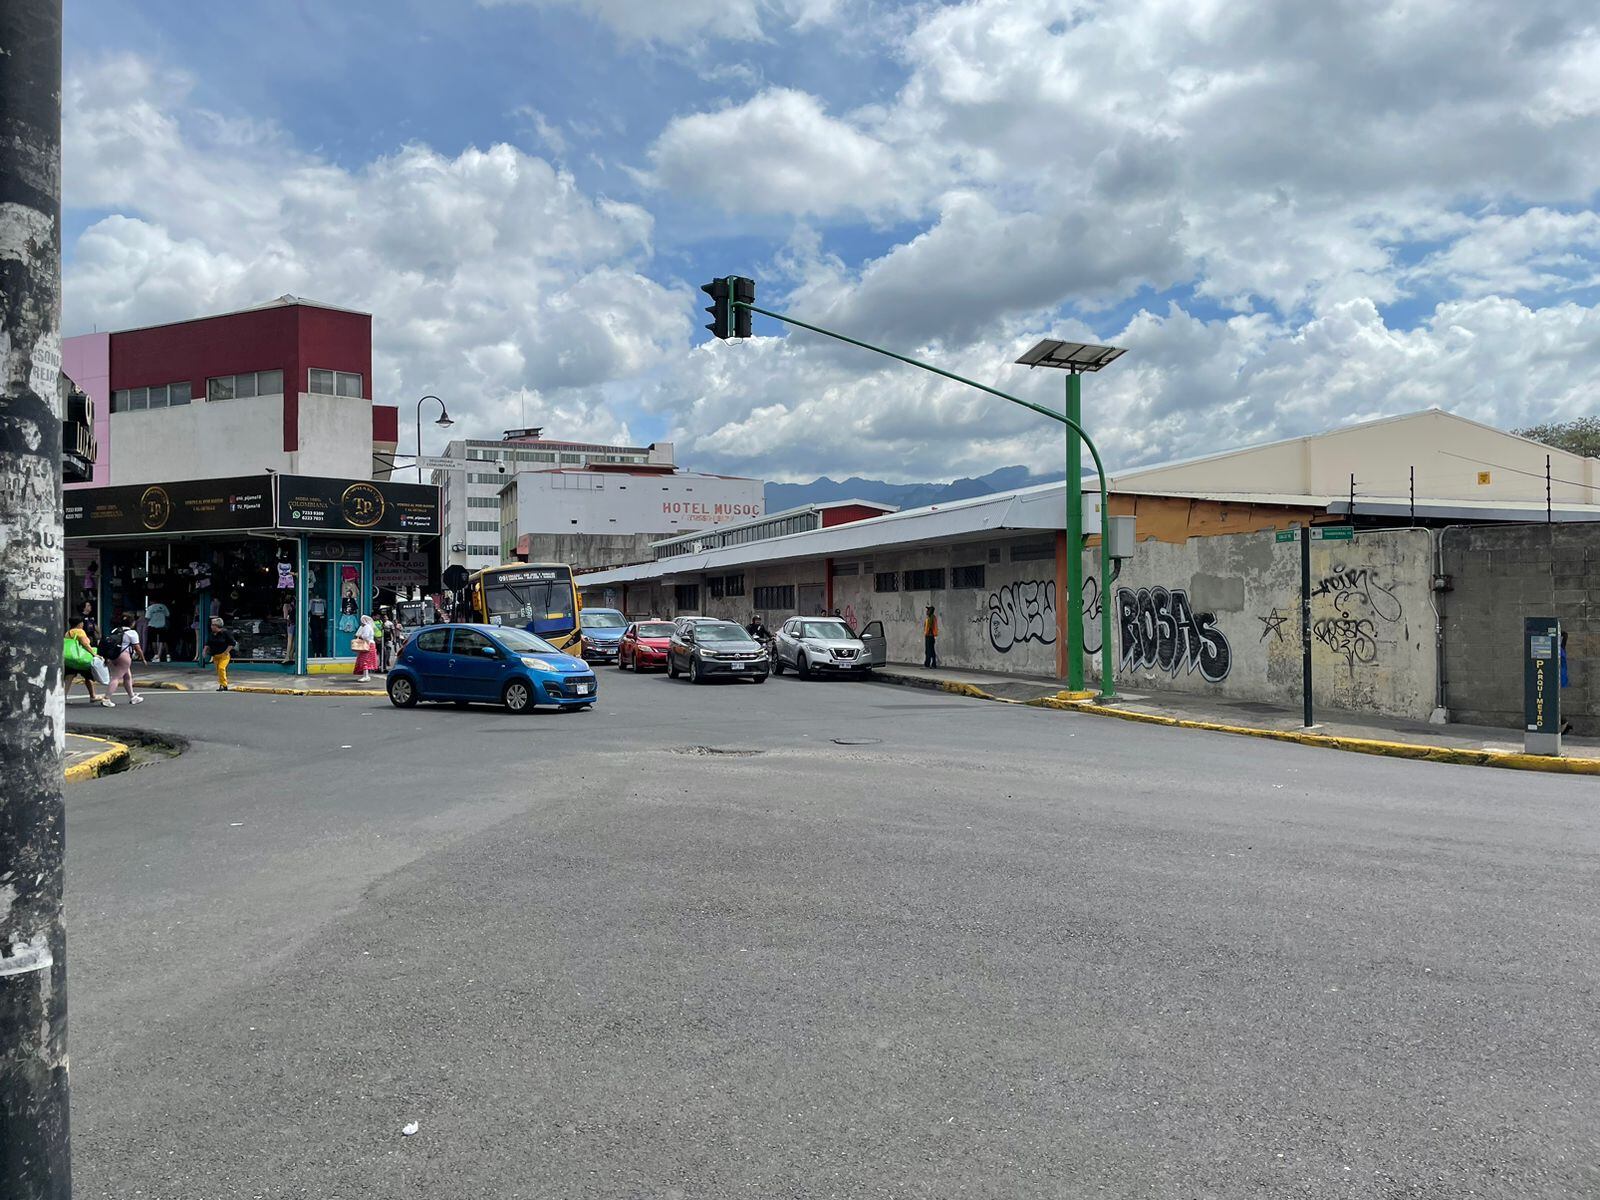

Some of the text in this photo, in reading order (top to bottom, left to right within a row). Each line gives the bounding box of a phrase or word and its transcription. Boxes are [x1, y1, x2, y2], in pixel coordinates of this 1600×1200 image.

[288, 500, 328, 508] COLOMBIANA
[663, 502, 760, 515] HOTEL MUSOC
